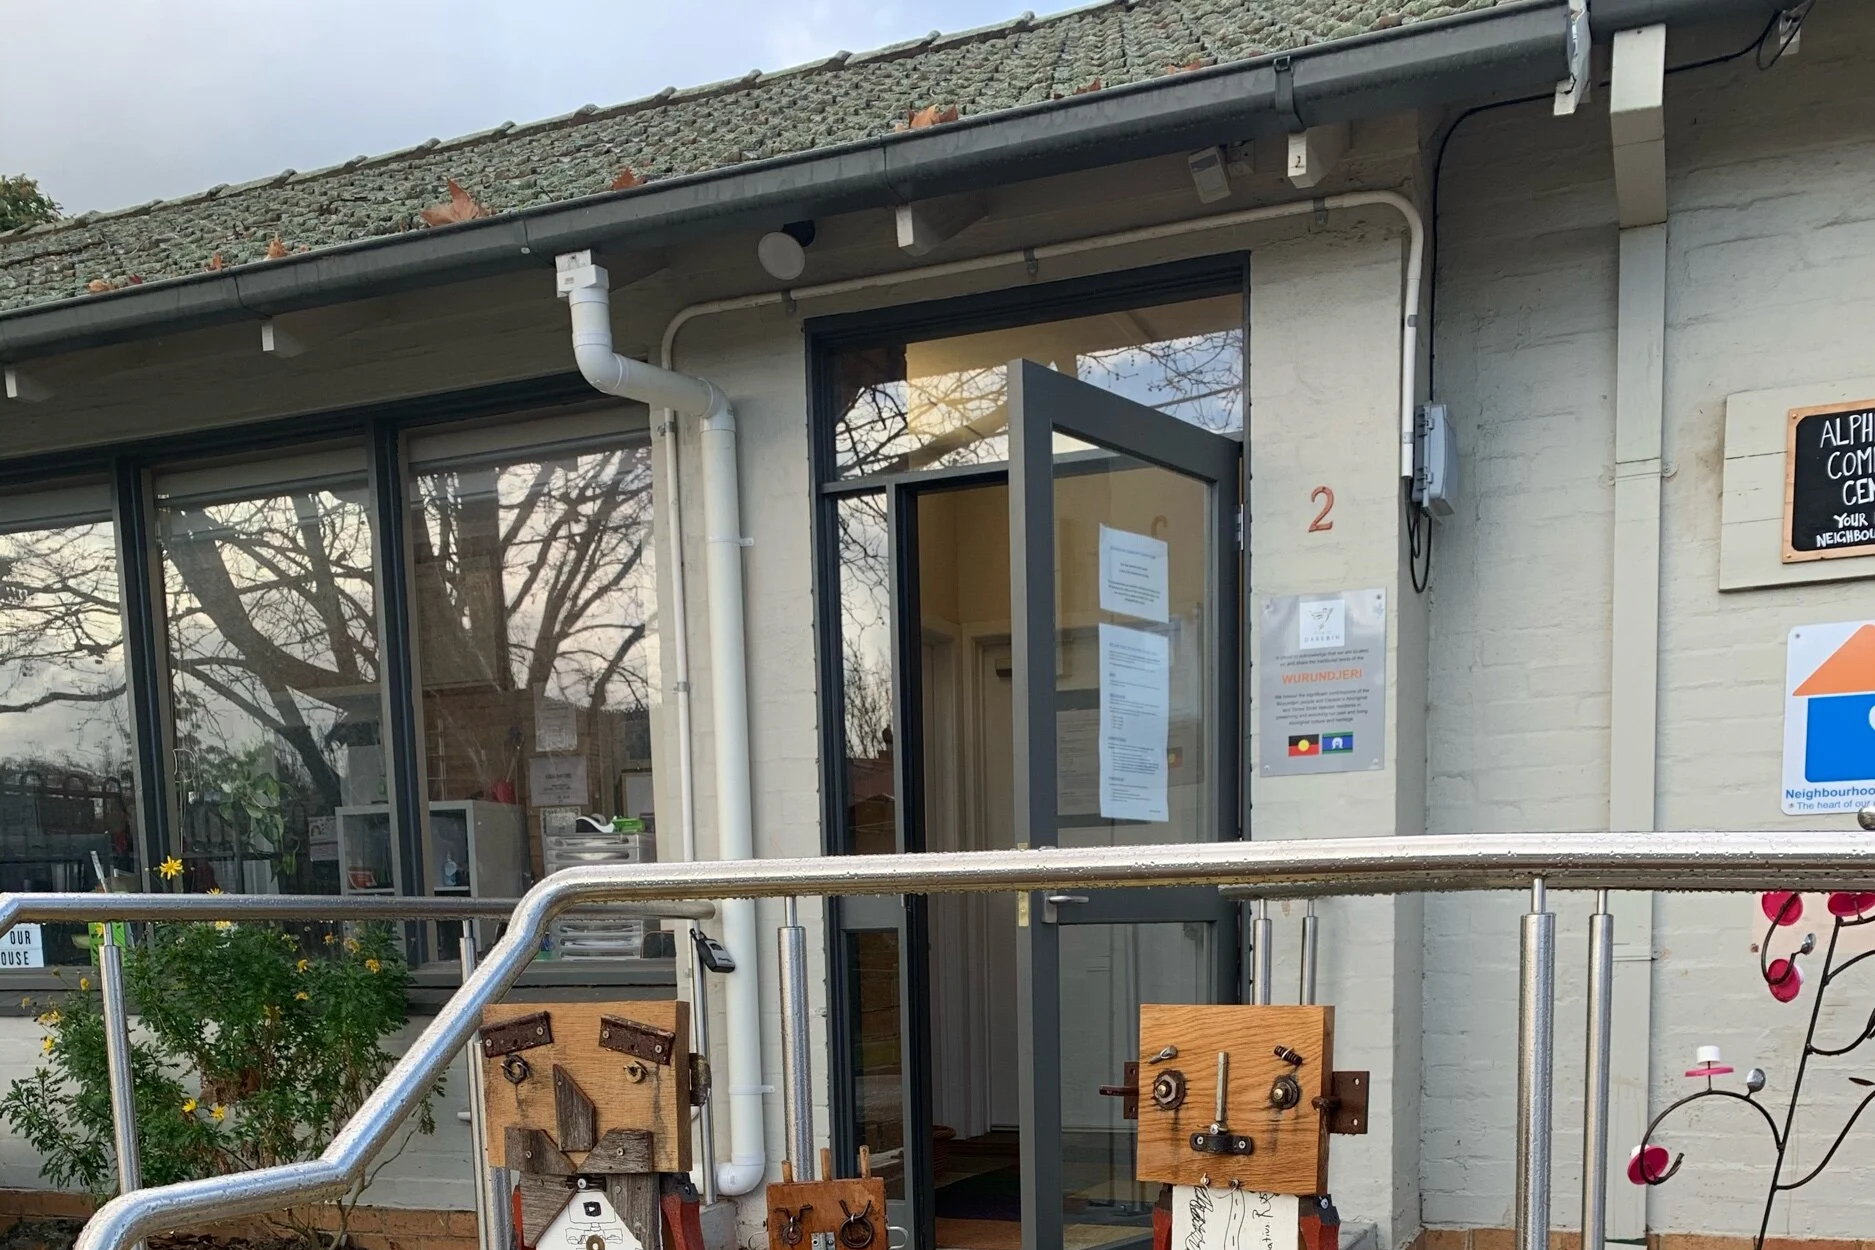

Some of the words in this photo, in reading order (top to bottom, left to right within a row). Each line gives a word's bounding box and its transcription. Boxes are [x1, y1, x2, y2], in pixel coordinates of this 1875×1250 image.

[1820, 413, 1873, 448] ALPH
[1309, 486, 1333, 532] 2
[1282, 668, 1363, 684] WURUNDJERI
[1797, 802, 1814, 810] The
[1817, 801, 1840, 809] heart
[1843, 799, 1853, 808] of
[10, 930, 31, 945] OUR
